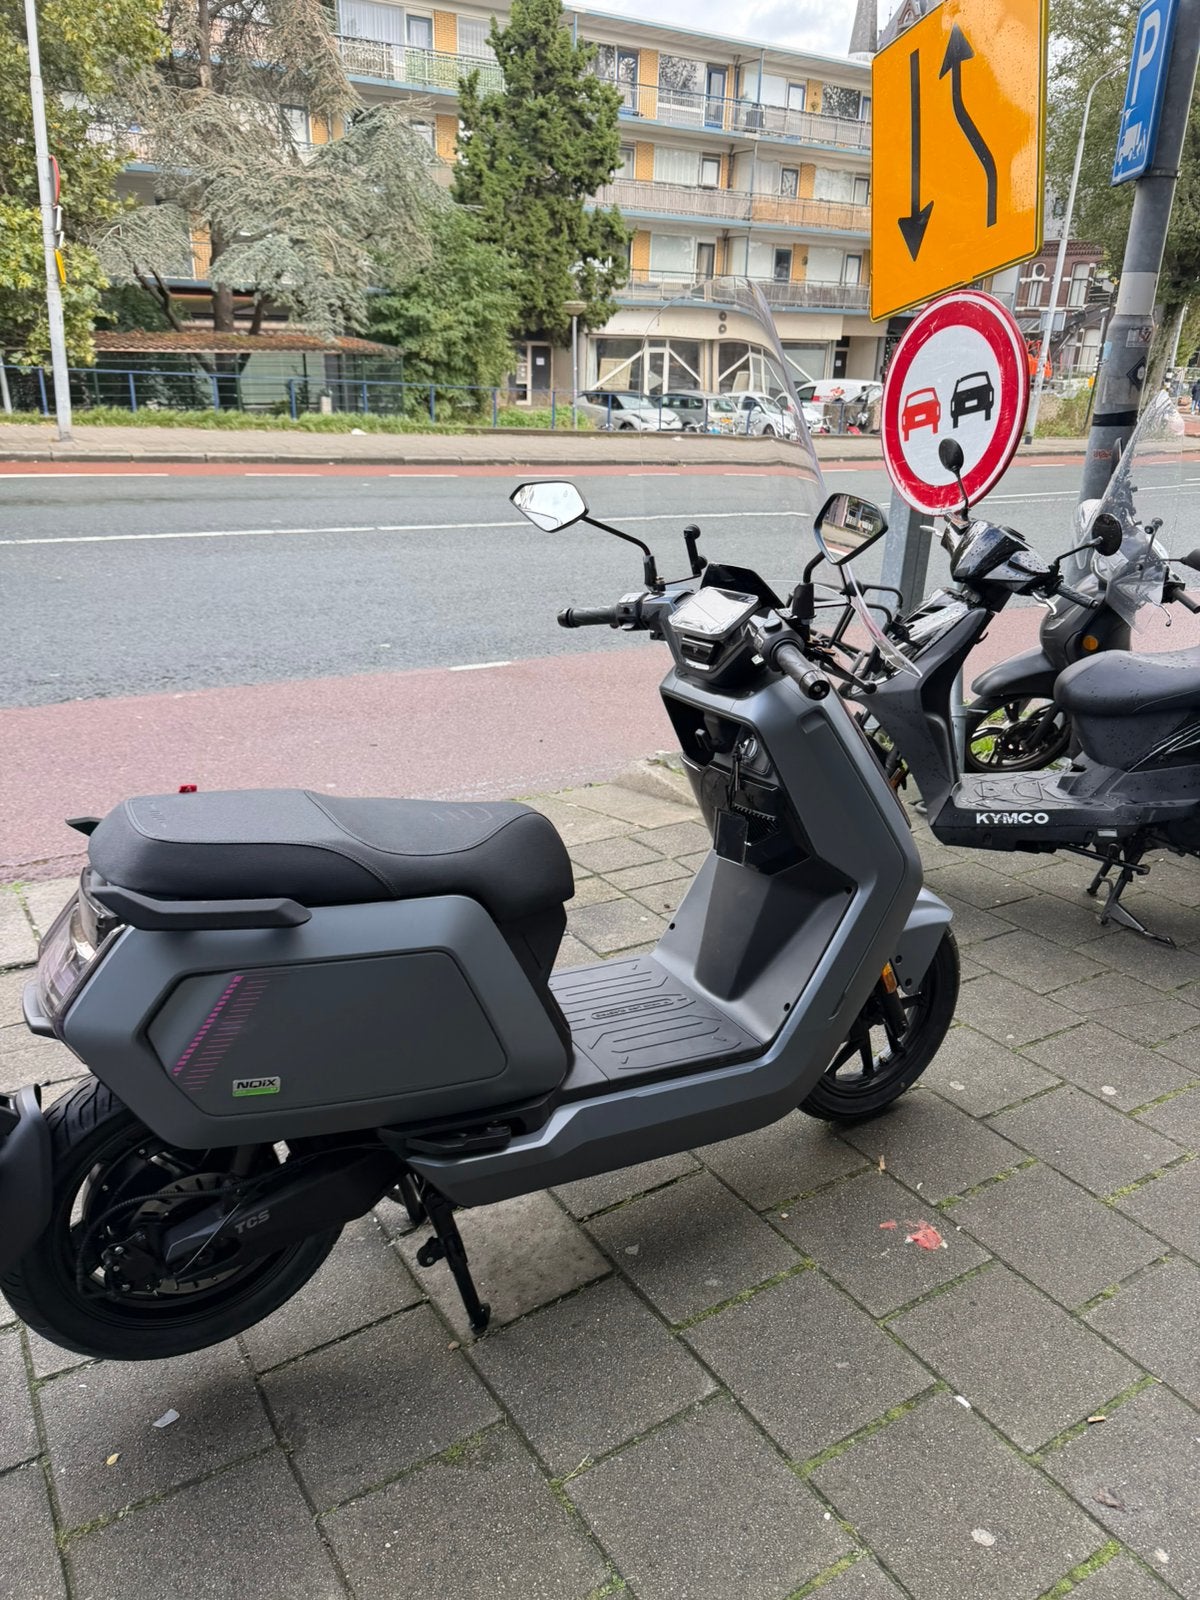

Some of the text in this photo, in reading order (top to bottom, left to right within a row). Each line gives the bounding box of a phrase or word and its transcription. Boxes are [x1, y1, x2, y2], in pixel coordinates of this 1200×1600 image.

[1132, 9, 1161, 106] P
[976, 812, 1049, 825] KYMCO
[235, 1210, 269, 1233] TCS
